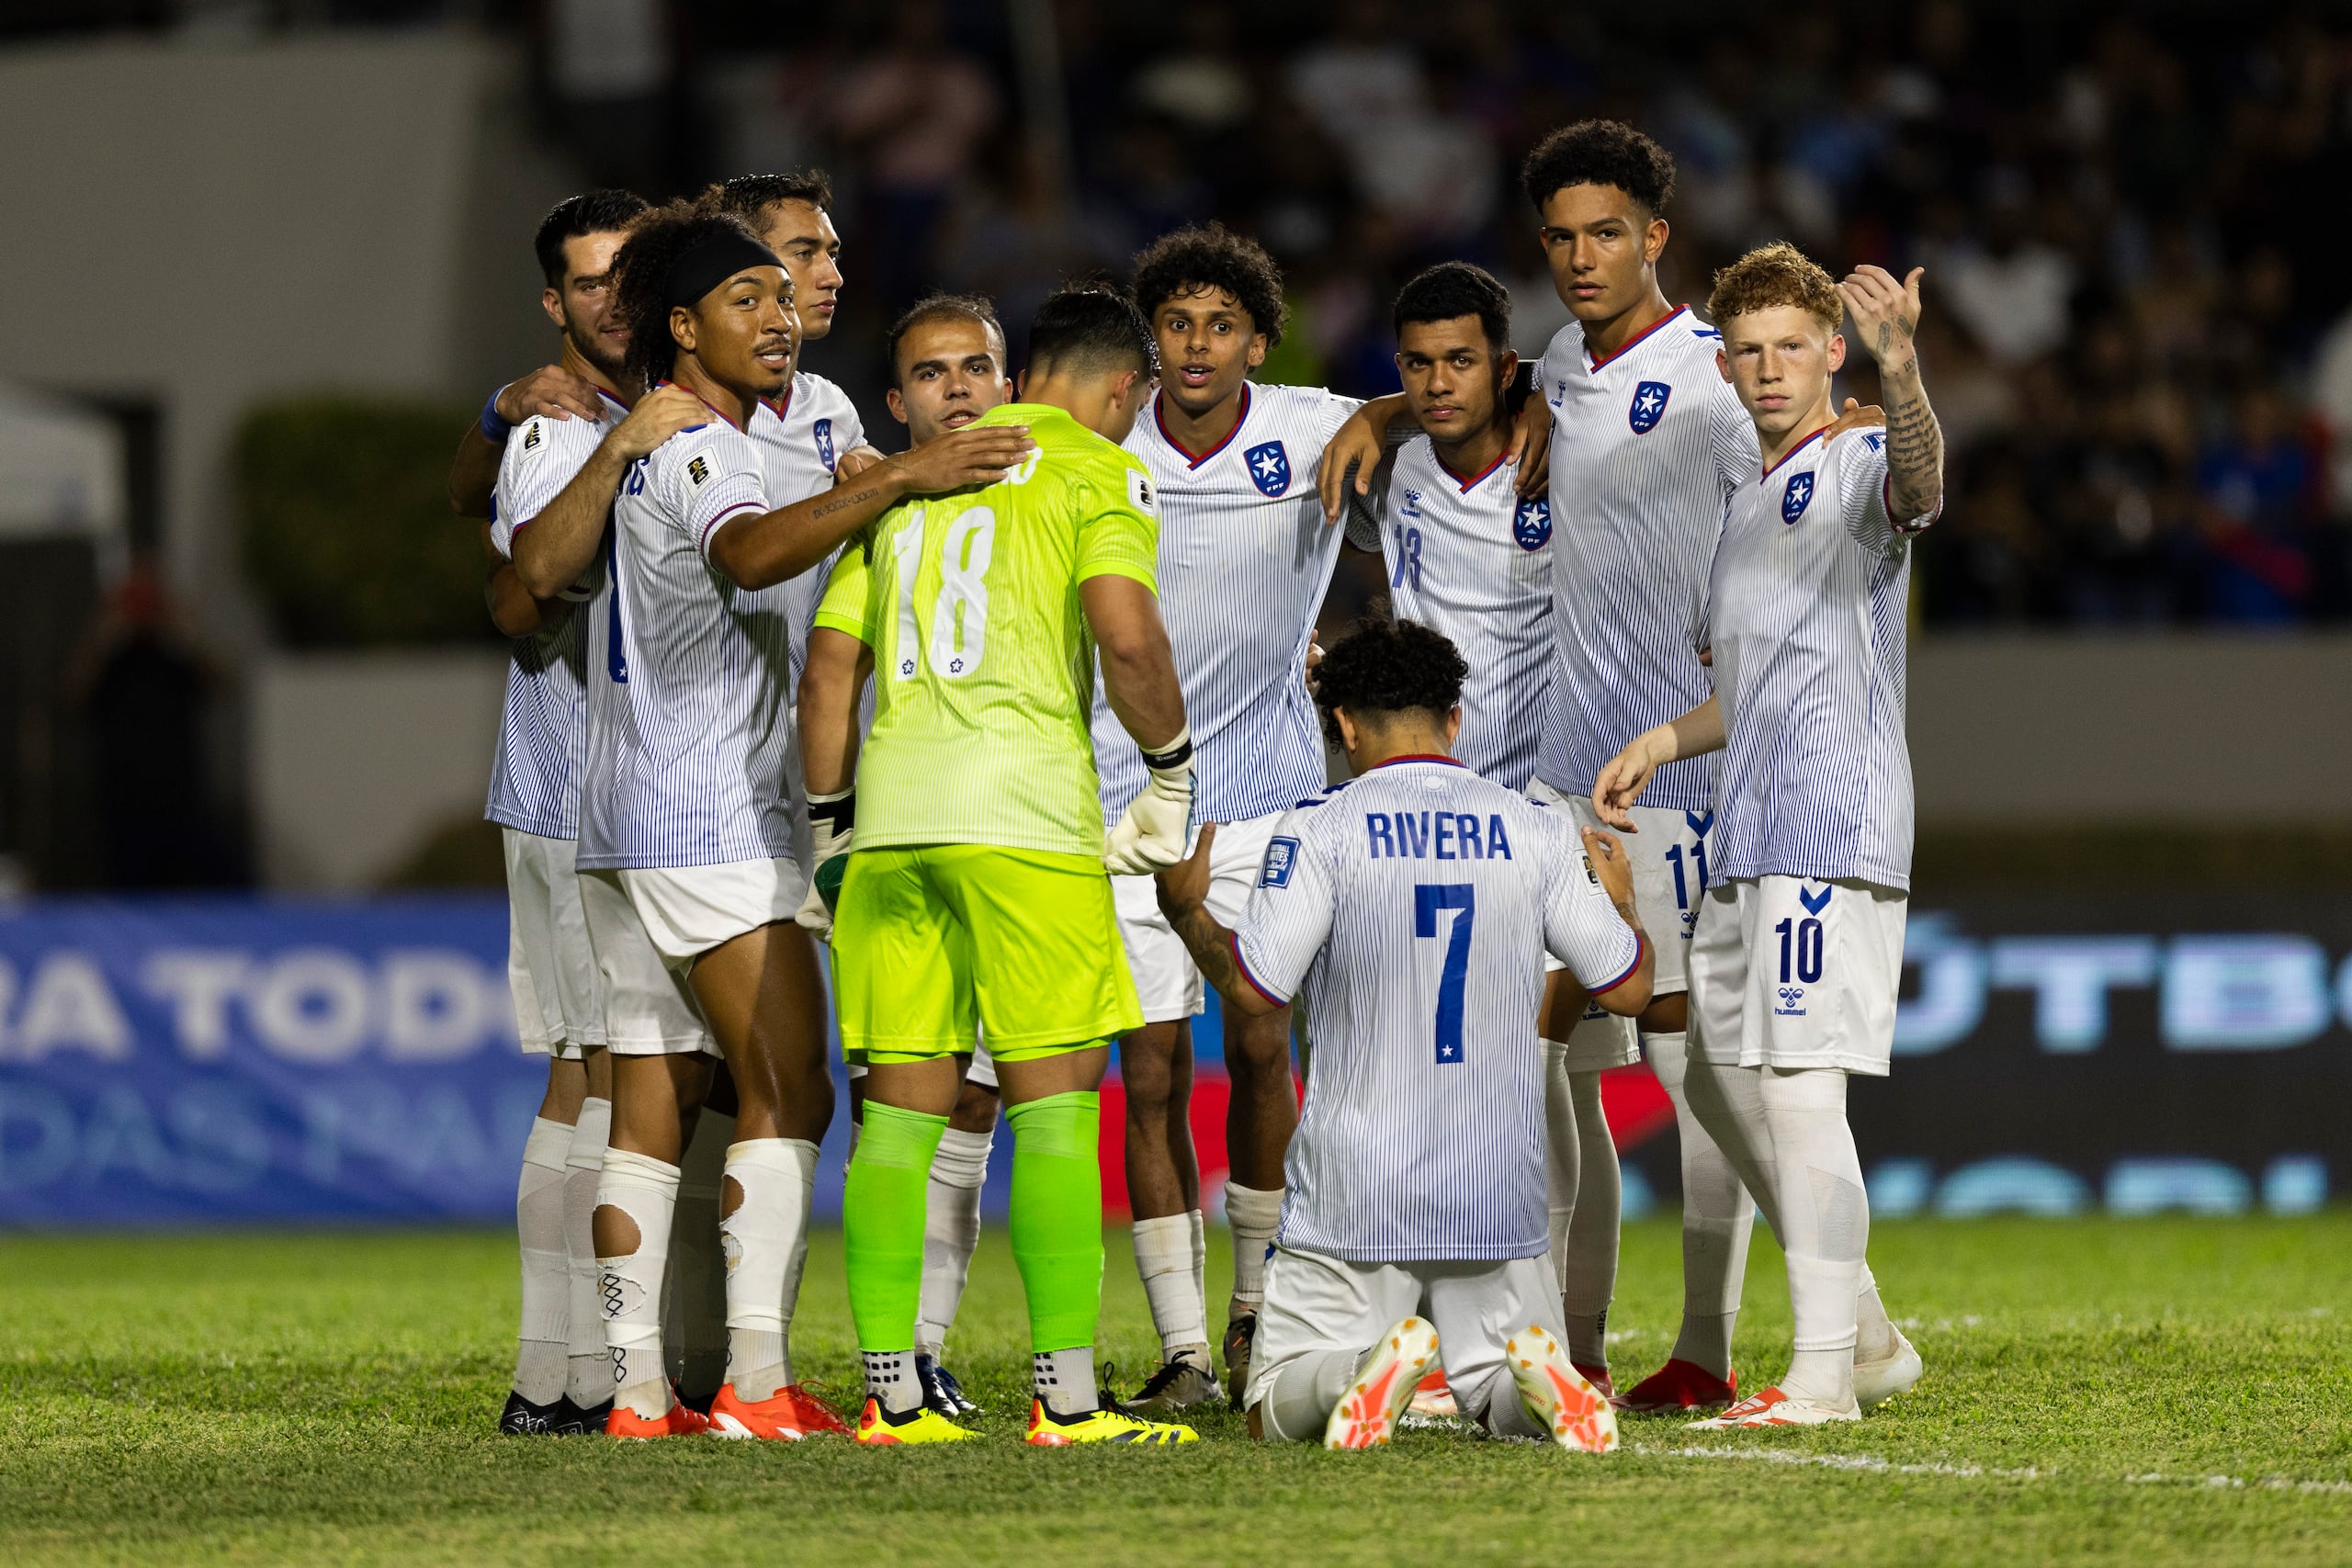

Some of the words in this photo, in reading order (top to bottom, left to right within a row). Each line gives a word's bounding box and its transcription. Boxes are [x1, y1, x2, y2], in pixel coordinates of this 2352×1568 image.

[893, 505, 996, 682] 18
[1392, 524, 1422, 592] 13
[1366, 810, 1512, 861] RIVERA
[1665, 840, 1709, 909] 11
[1414, 883, 1476, 1065] 7
[1775, 918, 1824, 993] 10
[142, 946, 526, 1063] TOD
[1775, 1007, 1806, 1016] hummel
